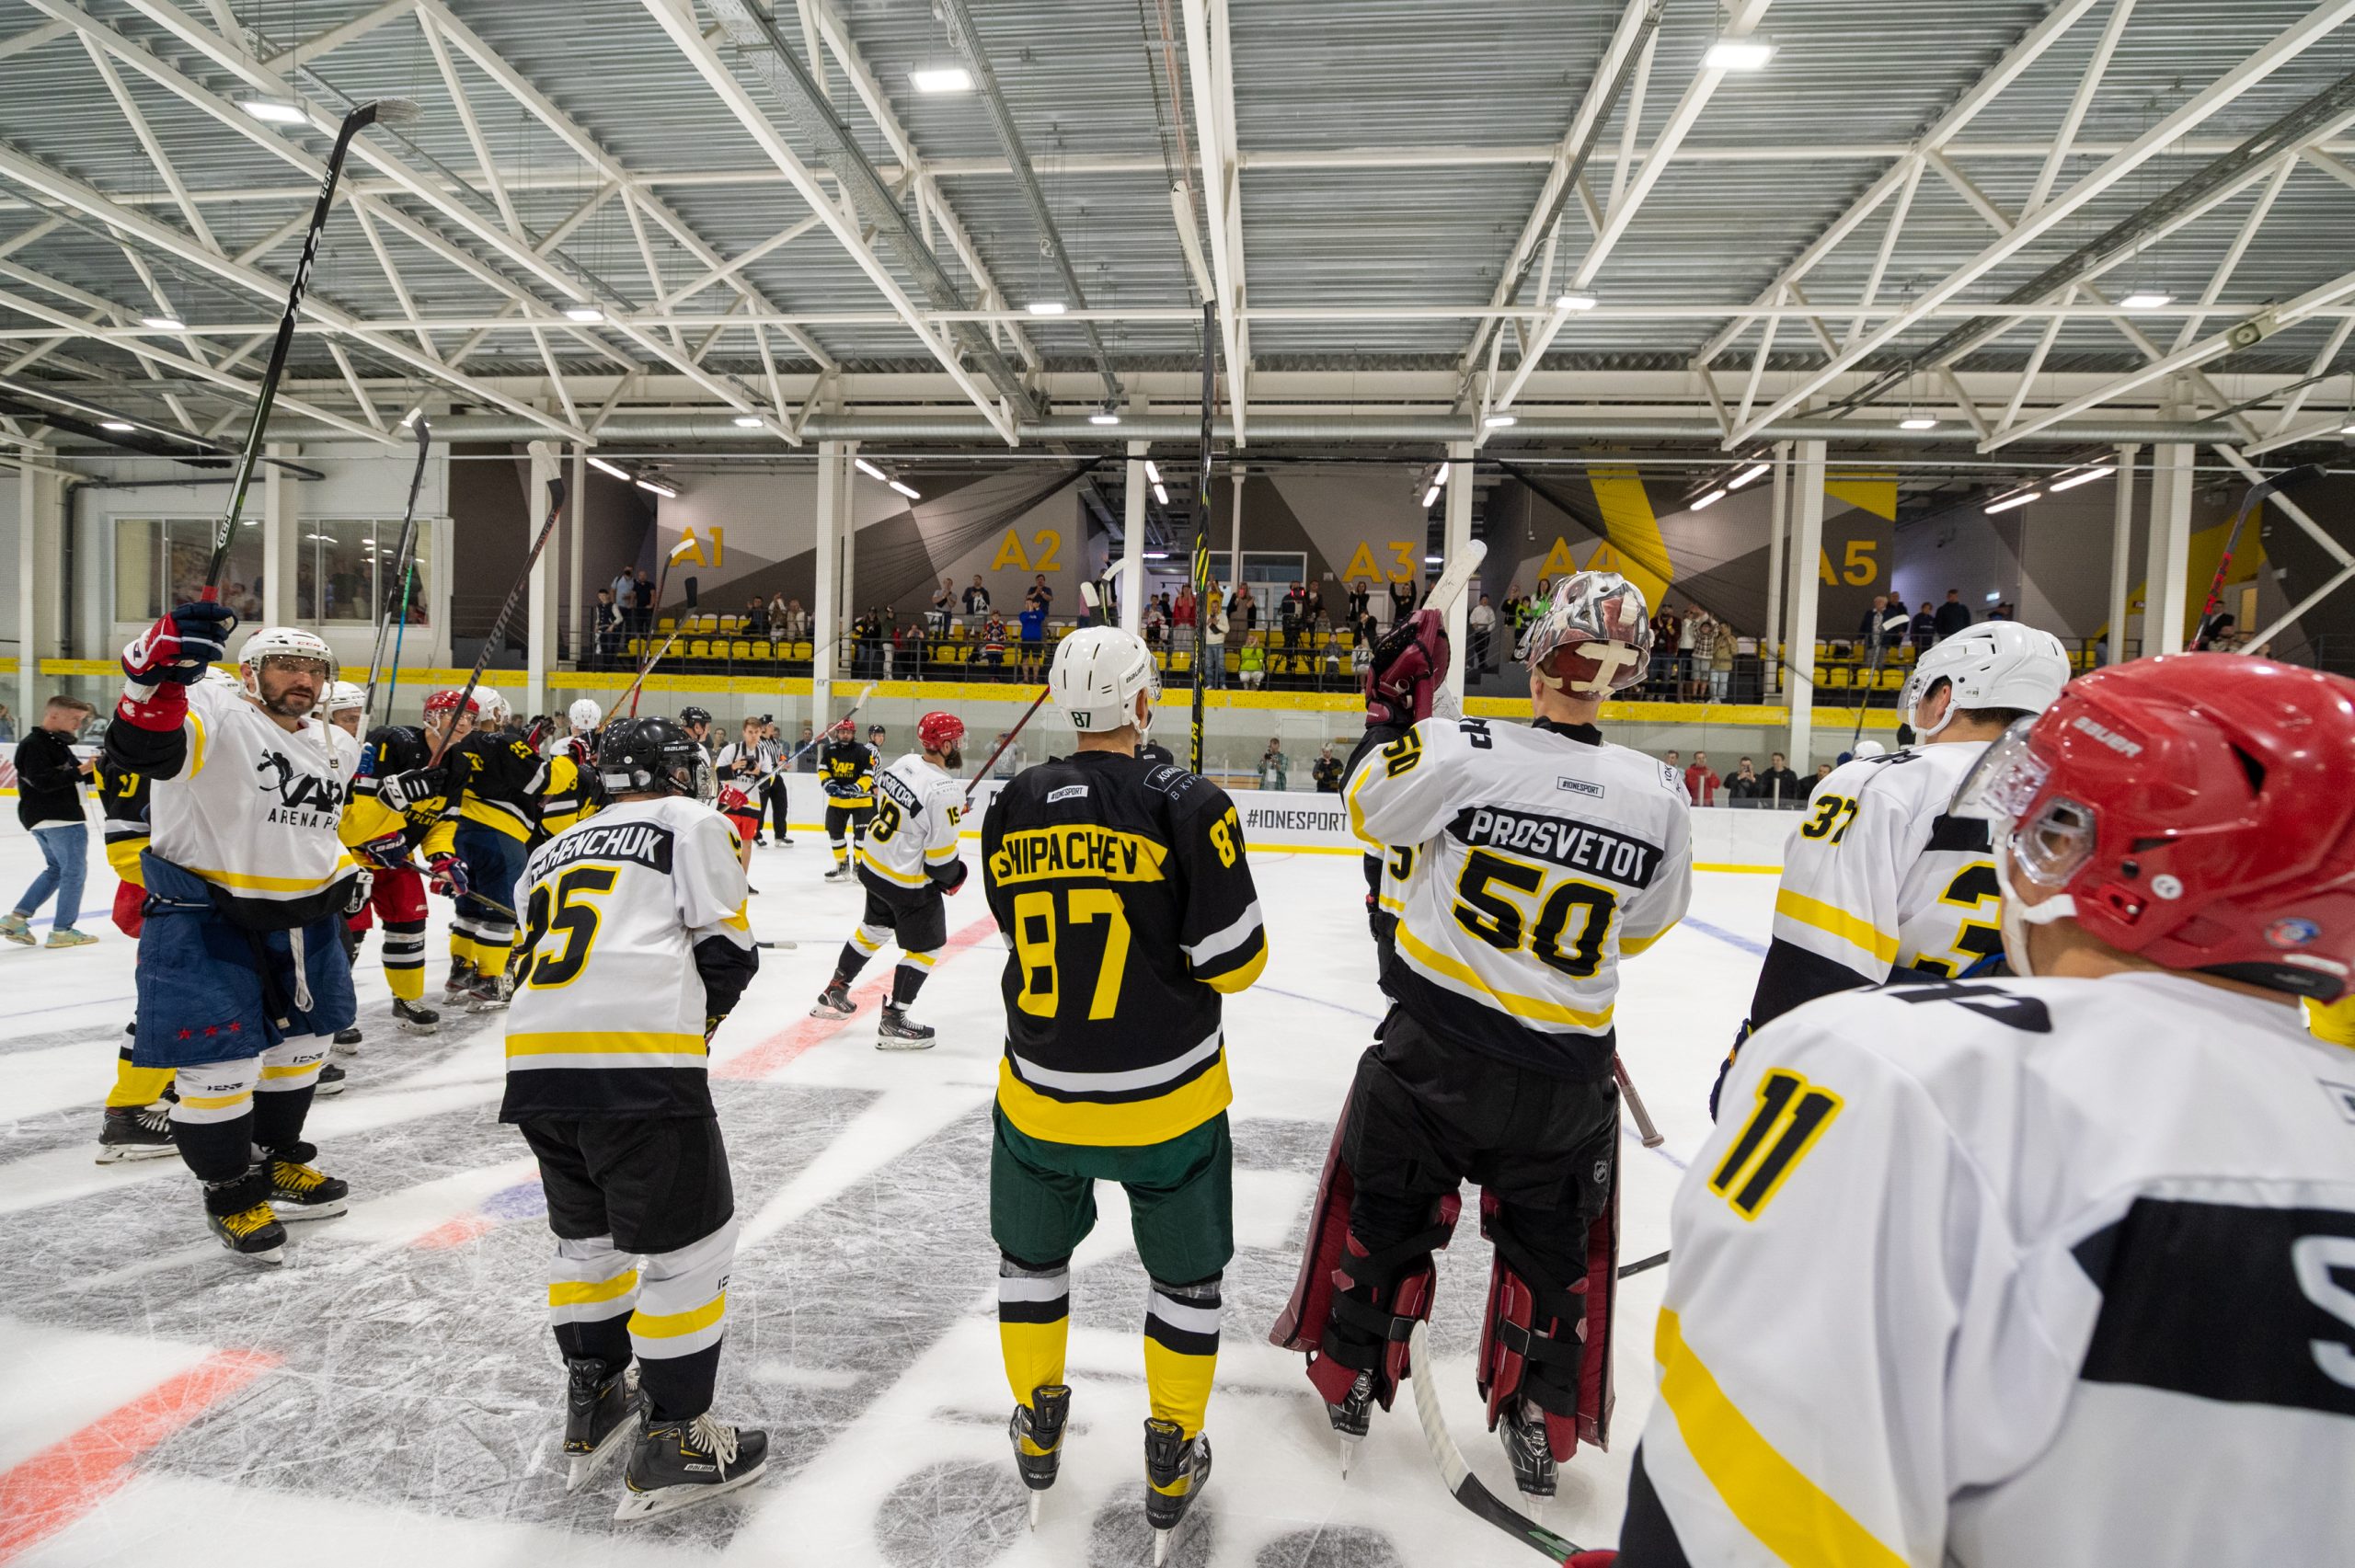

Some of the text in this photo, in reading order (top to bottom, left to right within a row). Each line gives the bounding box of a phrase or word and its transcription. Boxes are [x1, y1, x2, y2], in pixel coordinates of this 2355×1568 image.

[320, 168, 333, 200] CCM
[218, 514, 232, 545] CCM
[670, 526, 724, 567] A1
[990, 529, 1062, 572] A2
[1342, 541, 1418, 584] A3
[1125, 663, 1145, 684] BAUER
[1071, 711, 1091, 728] 87
[2072, 715, 2143, 758] BAUER
[663, 744, 689, 752] BAUER
[1562, 780, 1600, 795] #IONESPORT
[267, 807, 318, 829] ARENA
[1246, 808, 1347, 832] #IONESPORT
[1801, 795, 1860, 846] 37
[996, 831, 1138, 879] SHIPACHEV
[1452, 846, 1619, 980] 50
[1014, 888, 1132, 1021] 87
[1707, 1067, 1845, 1223] 11
[2292, 1234, 2355, 1389] S
